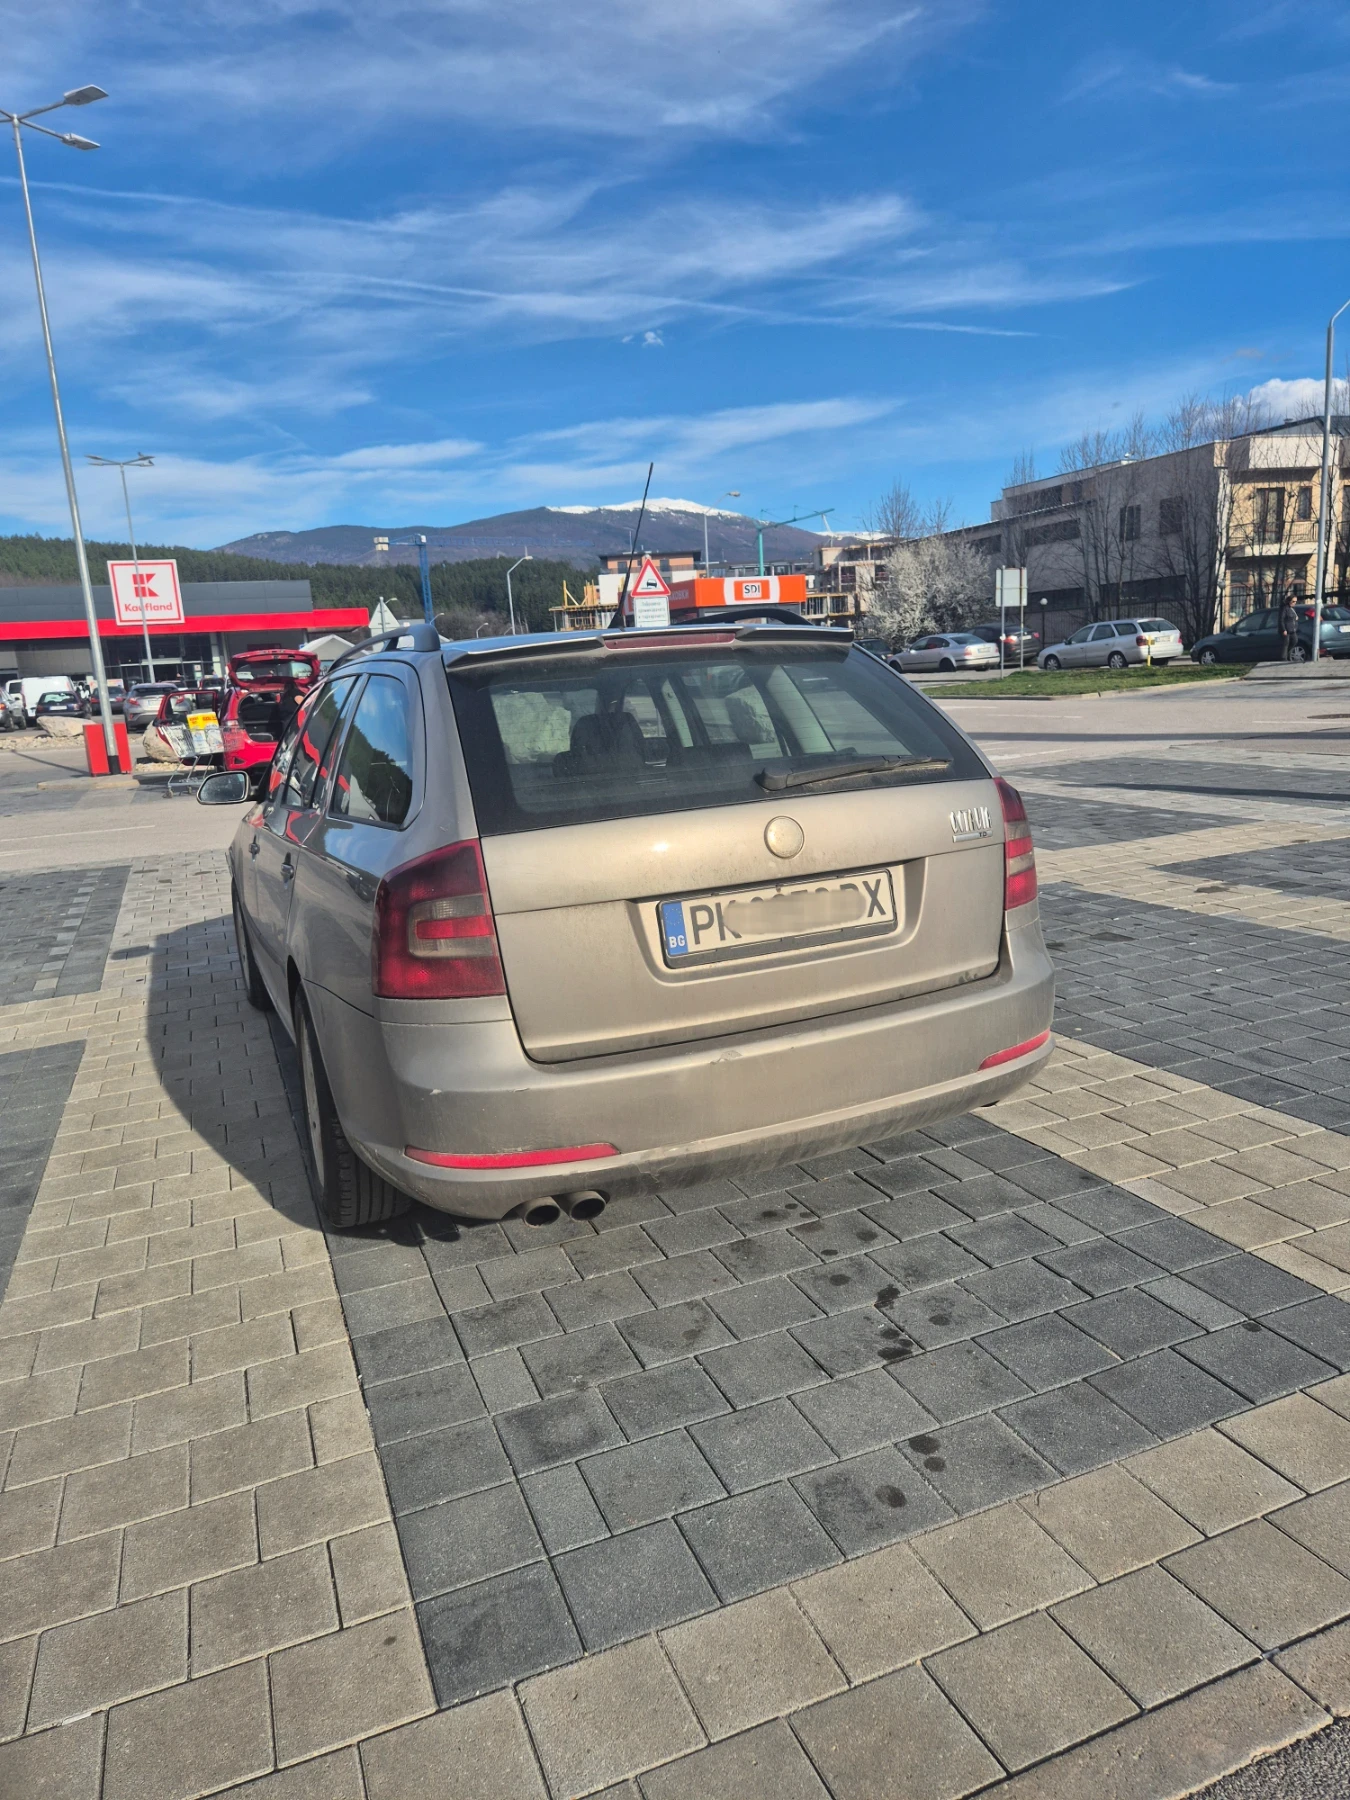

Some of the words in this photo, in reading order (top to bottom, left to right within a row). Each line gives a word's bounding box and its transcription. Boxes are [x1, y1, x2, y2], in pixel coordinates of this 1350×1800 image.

[744, 584, 761, 594] SDI
[949, 806, 992, 834] OCTAVIA
[668, 934, 686, 948] BG
